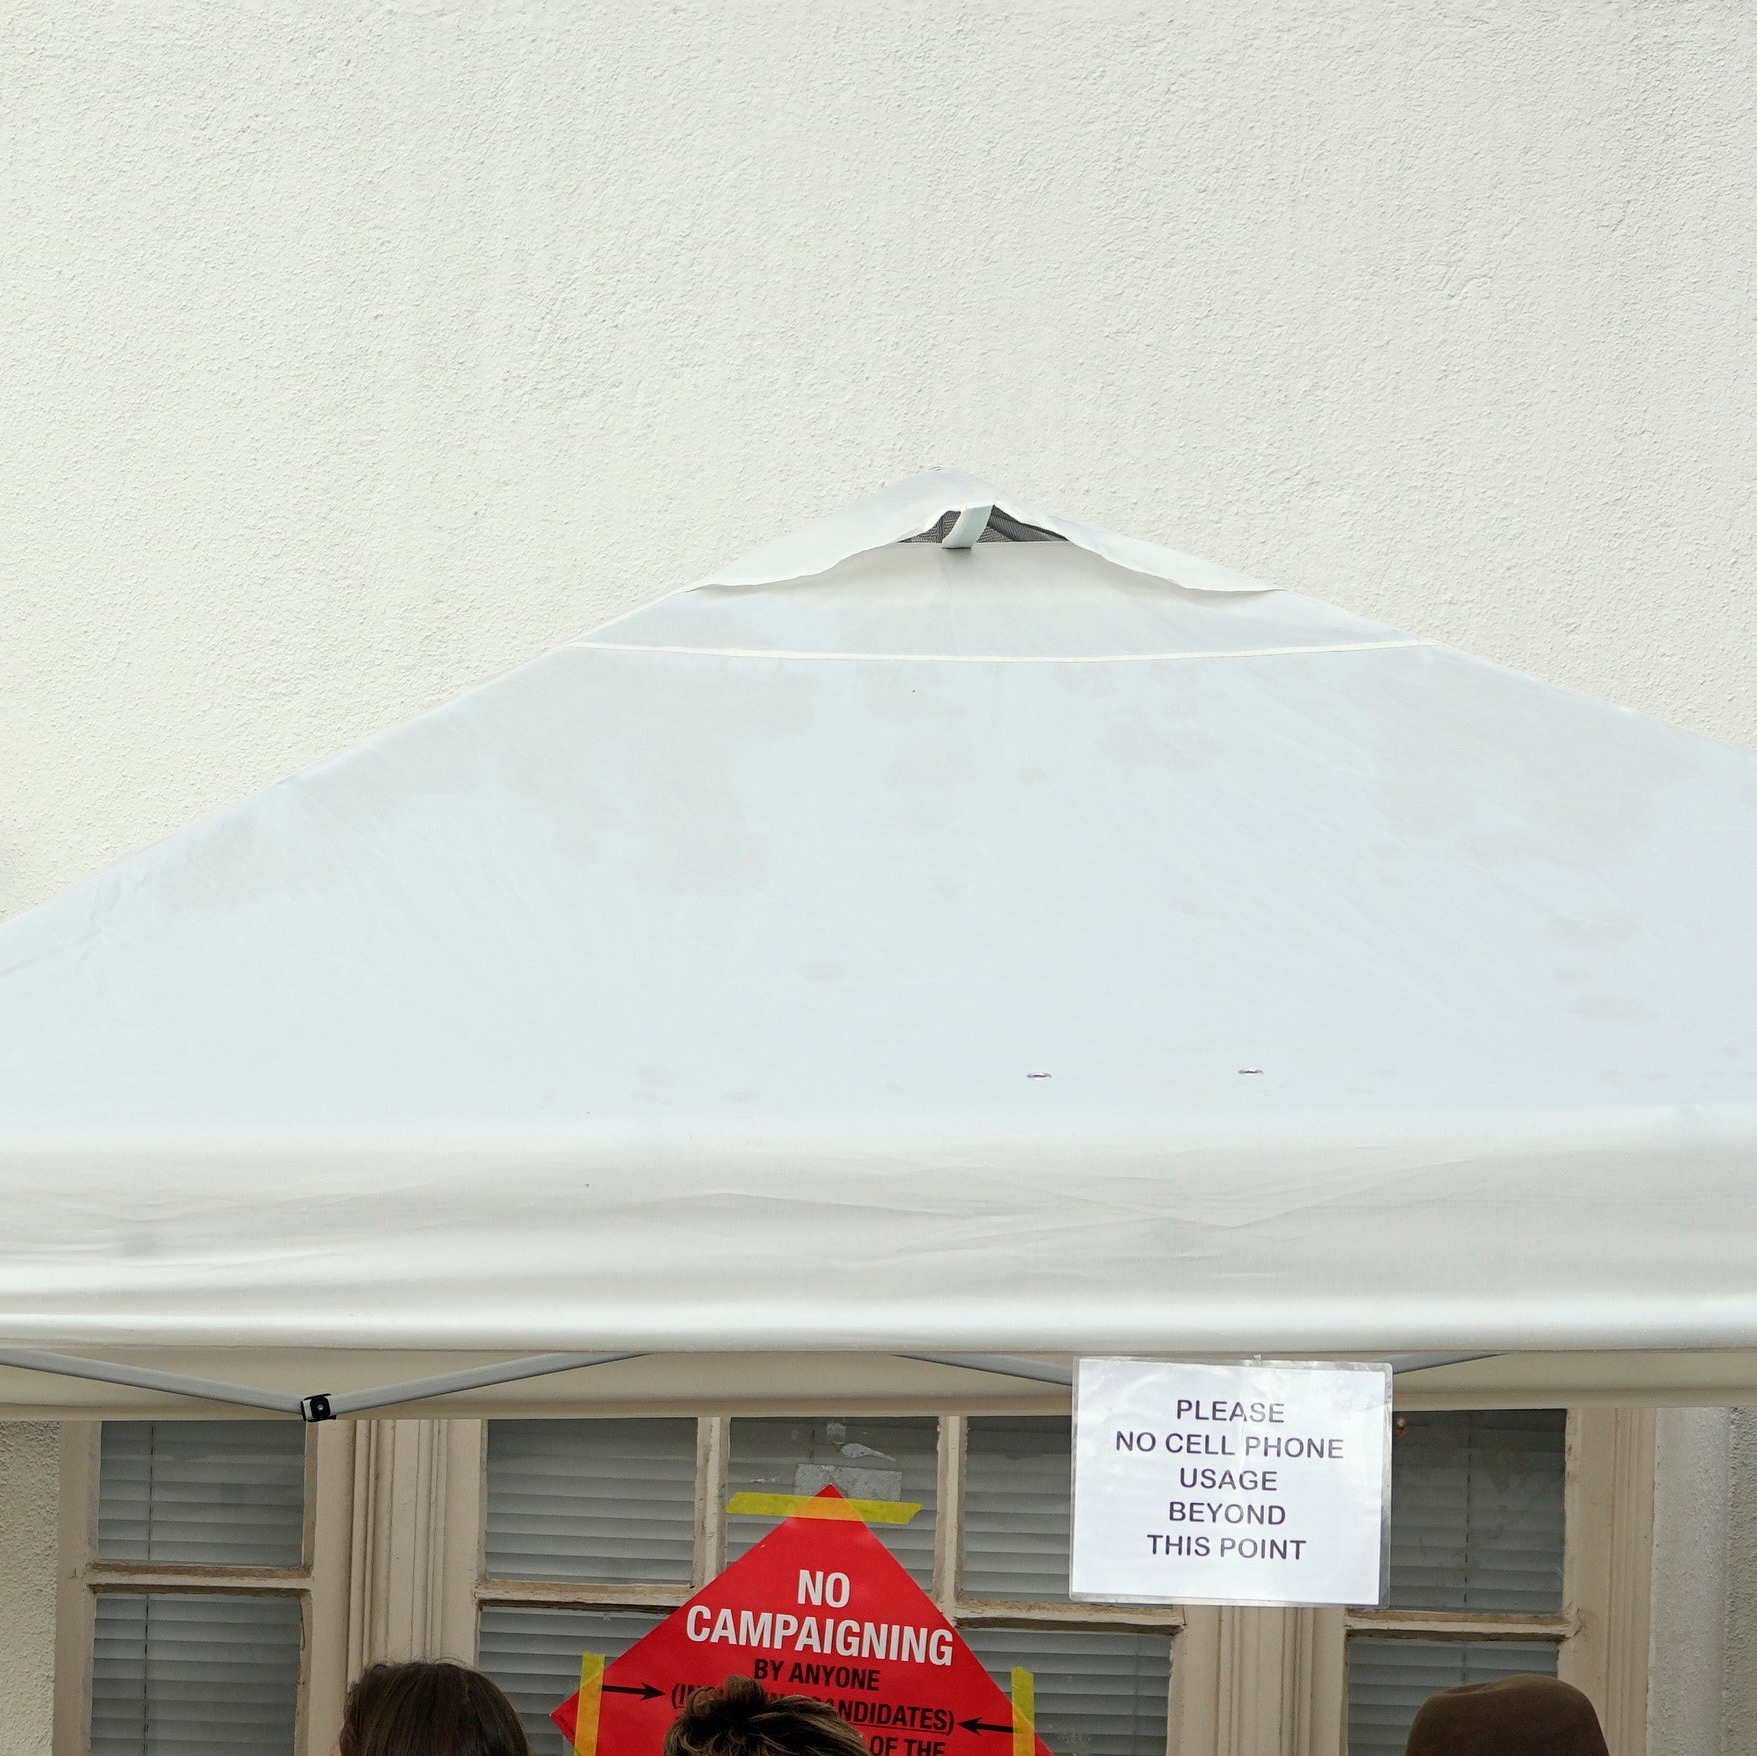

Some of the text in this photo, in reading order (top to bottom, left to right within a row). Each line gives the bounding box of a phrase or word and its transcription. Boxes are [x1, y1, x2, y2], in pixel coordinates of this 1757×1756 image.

[1176, 1399, 1285, 1423] PLEASE
[1115, 1431, 1344, 1459] NO CELL PHONE
[1179, 1467, 1278, 1491] USAGE
[1168, 1501, 1286, 1525] BEYOND
[1147, 1534, 1307, 1560] THIS POINT
[796, 1569, 851, 1609] NO
[686, 1604, 954, 1667] CAMPAIGNING
[753, 1658, 882, 1692] BY ANYONE
